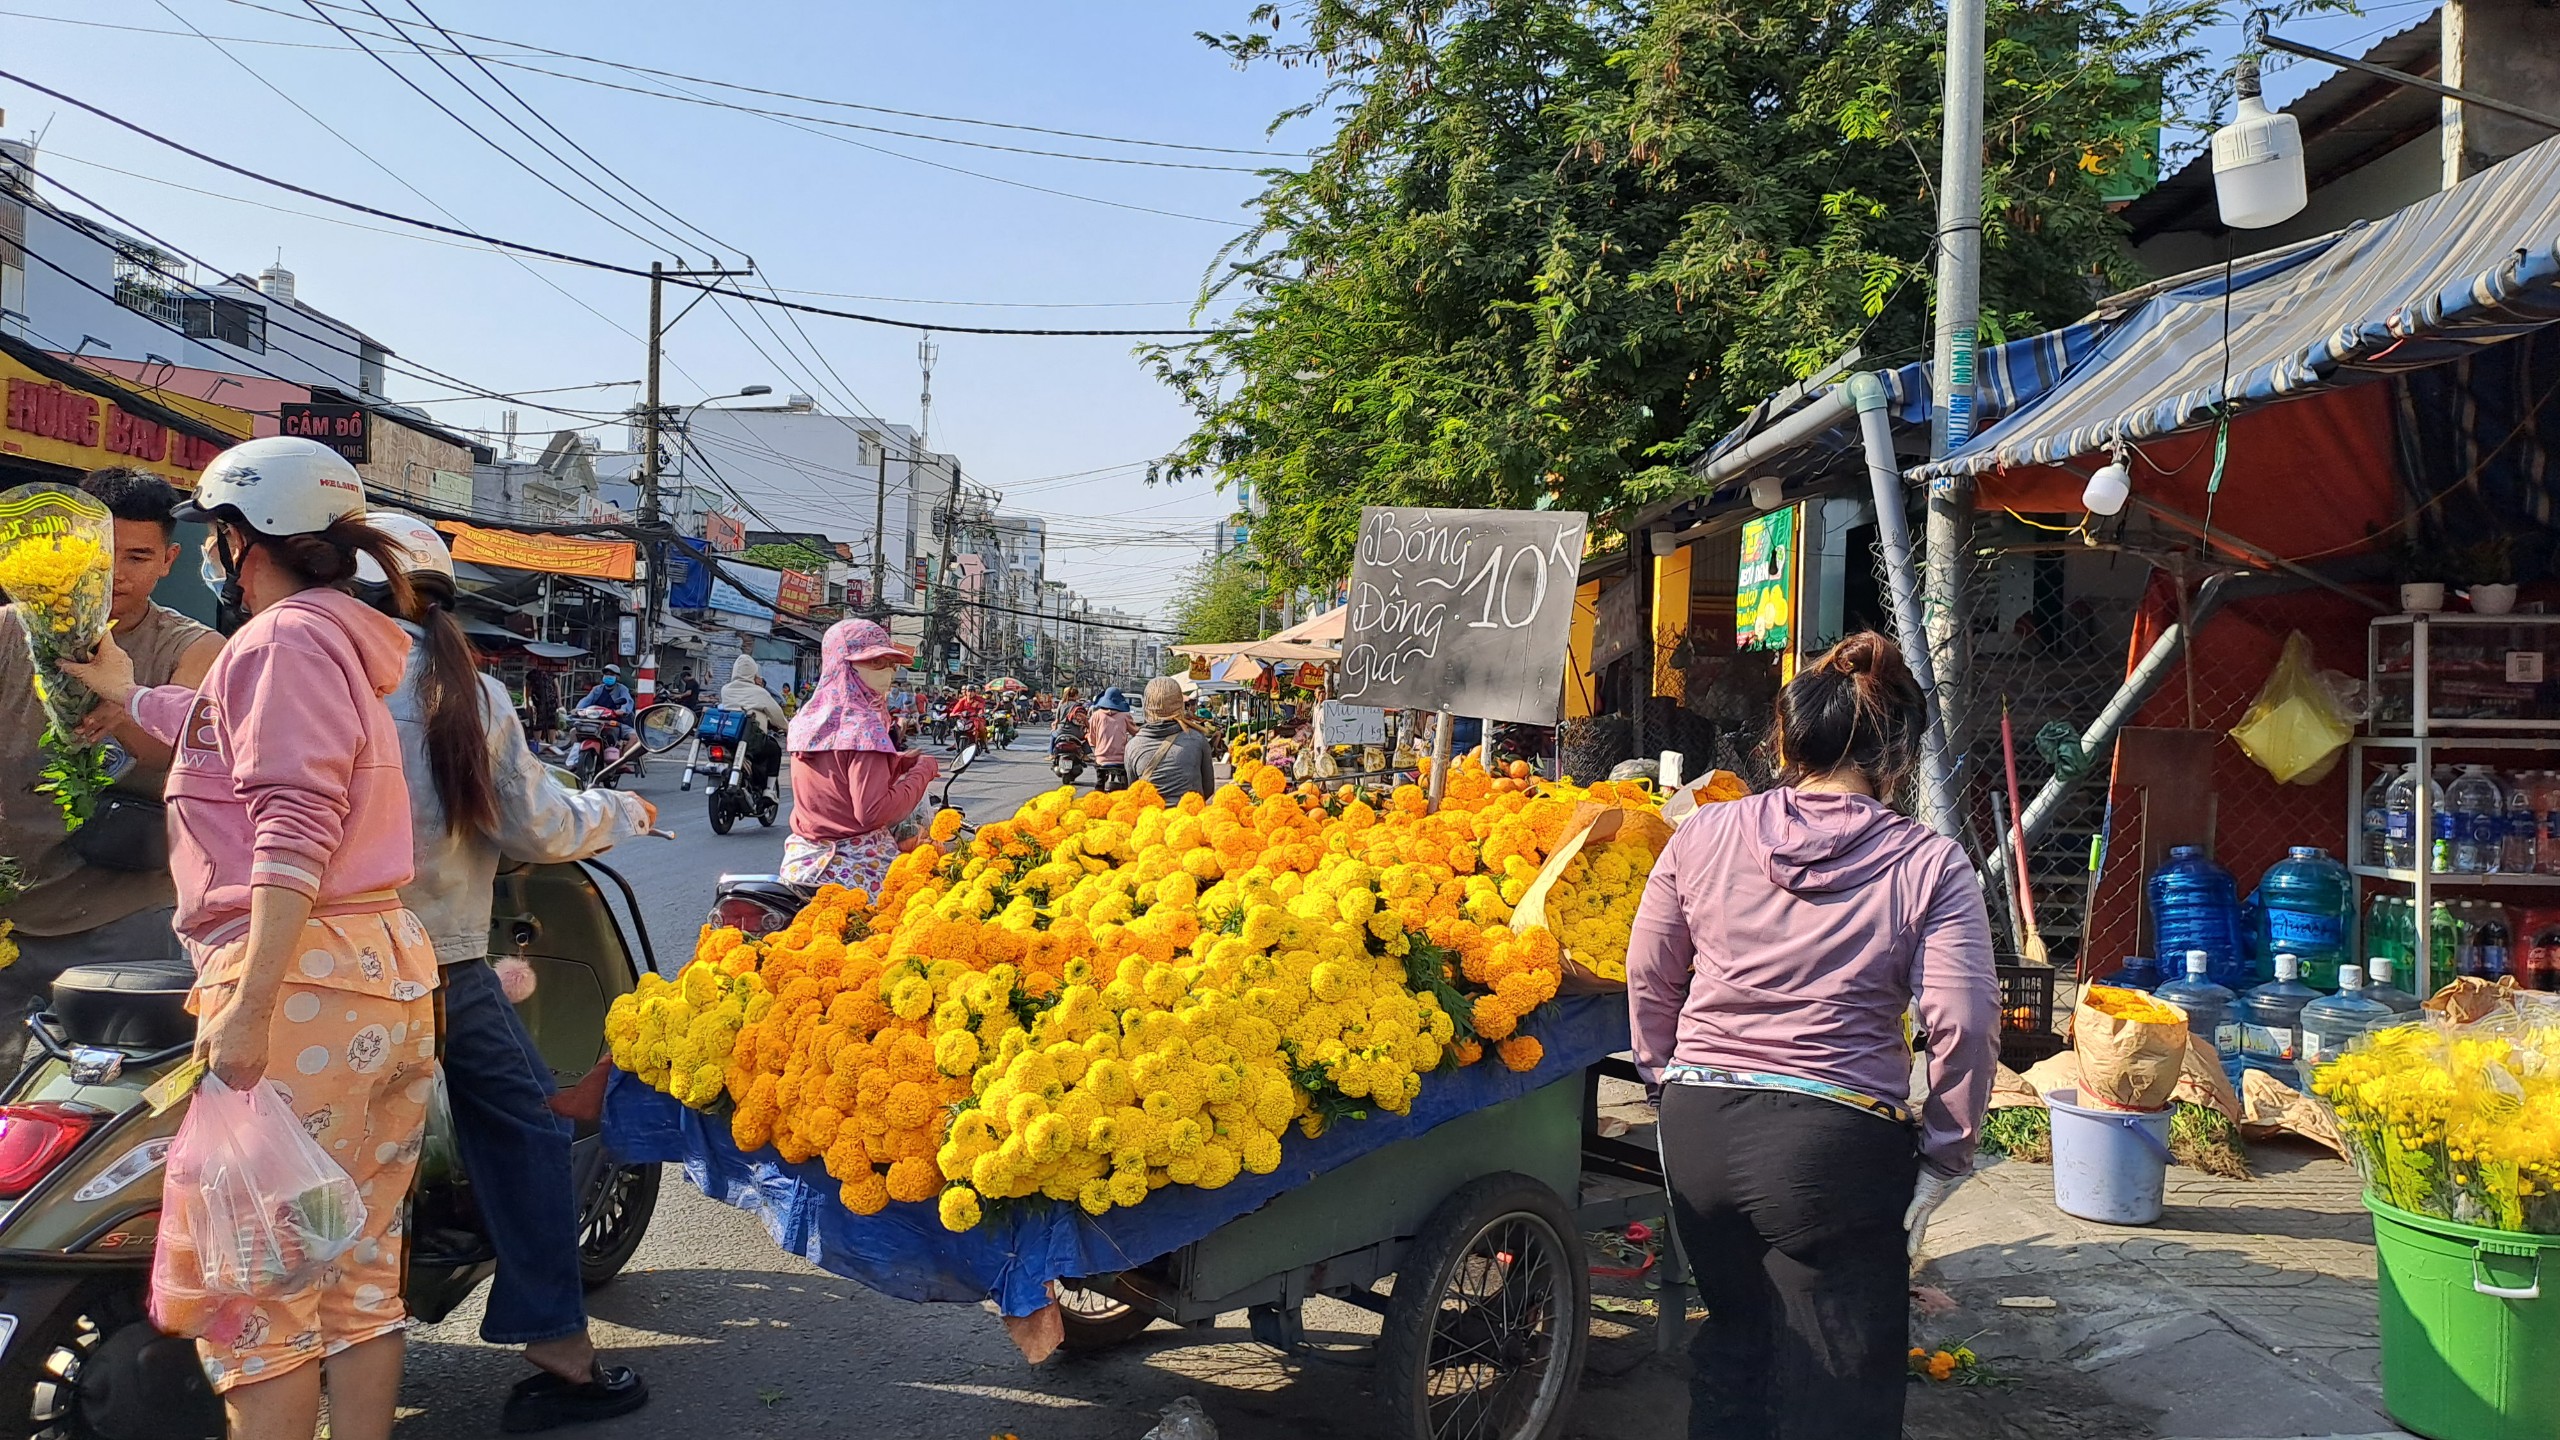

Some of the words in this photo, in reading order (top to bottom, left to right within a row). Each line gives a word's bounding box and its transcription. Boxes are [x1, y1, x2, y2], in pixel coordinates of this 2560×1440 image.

[286, 409, 329, 436] CẦM
[335, 411, 362, 437] ĐỒ
[1362, 510, 1471, 589] Bông
[1352, 568, 1446, 664] Đồng
